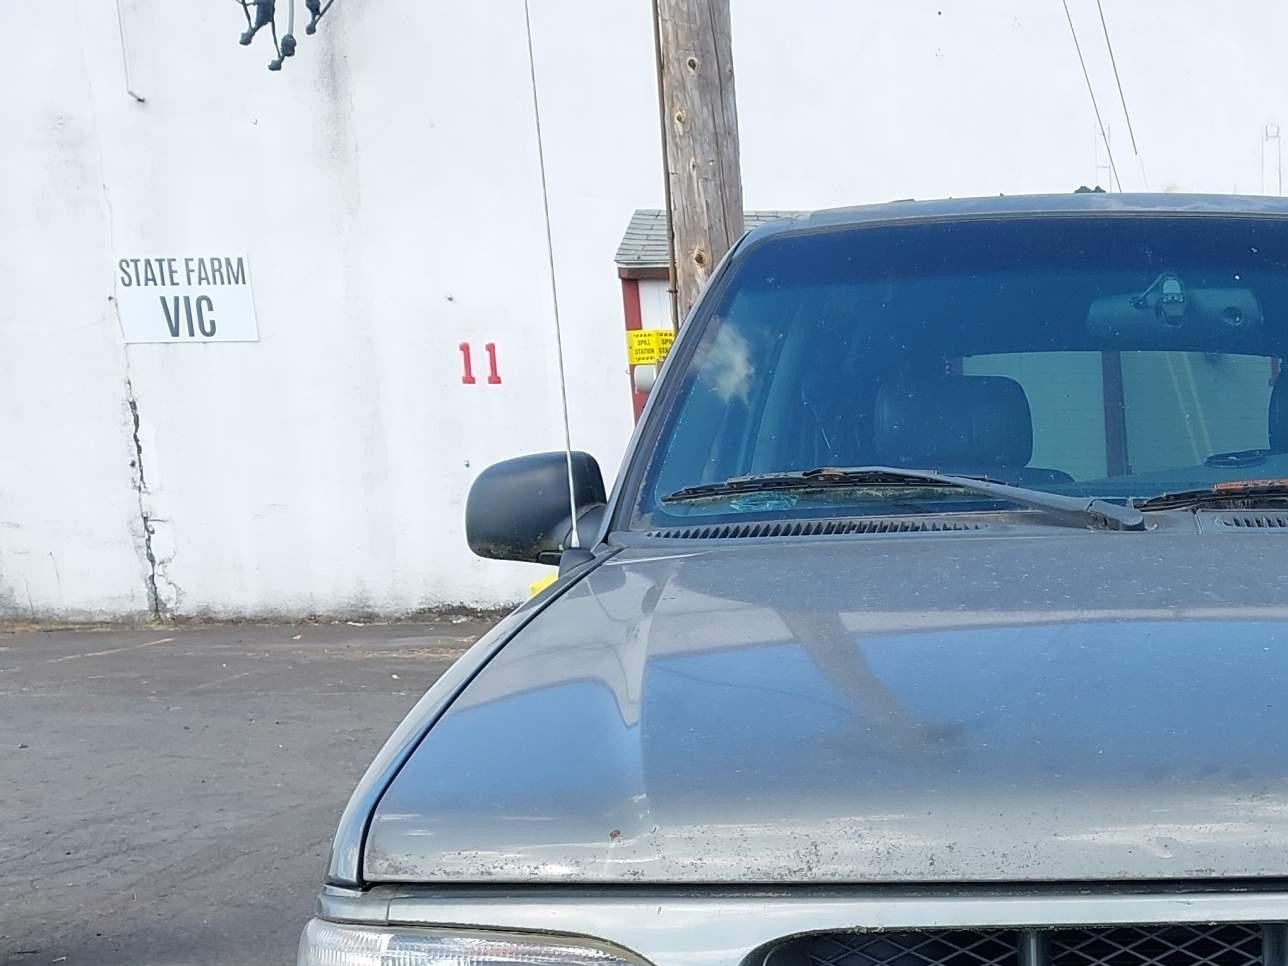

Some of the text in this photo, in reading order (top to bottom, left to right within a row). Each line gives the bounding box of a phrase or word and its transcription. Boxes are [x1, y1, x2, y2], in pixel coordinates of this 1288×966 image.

[118, 256, 247, 287] STATE FARM
[159, 294, 217, 338] VIC
[459, 342, 502, 385] 11
